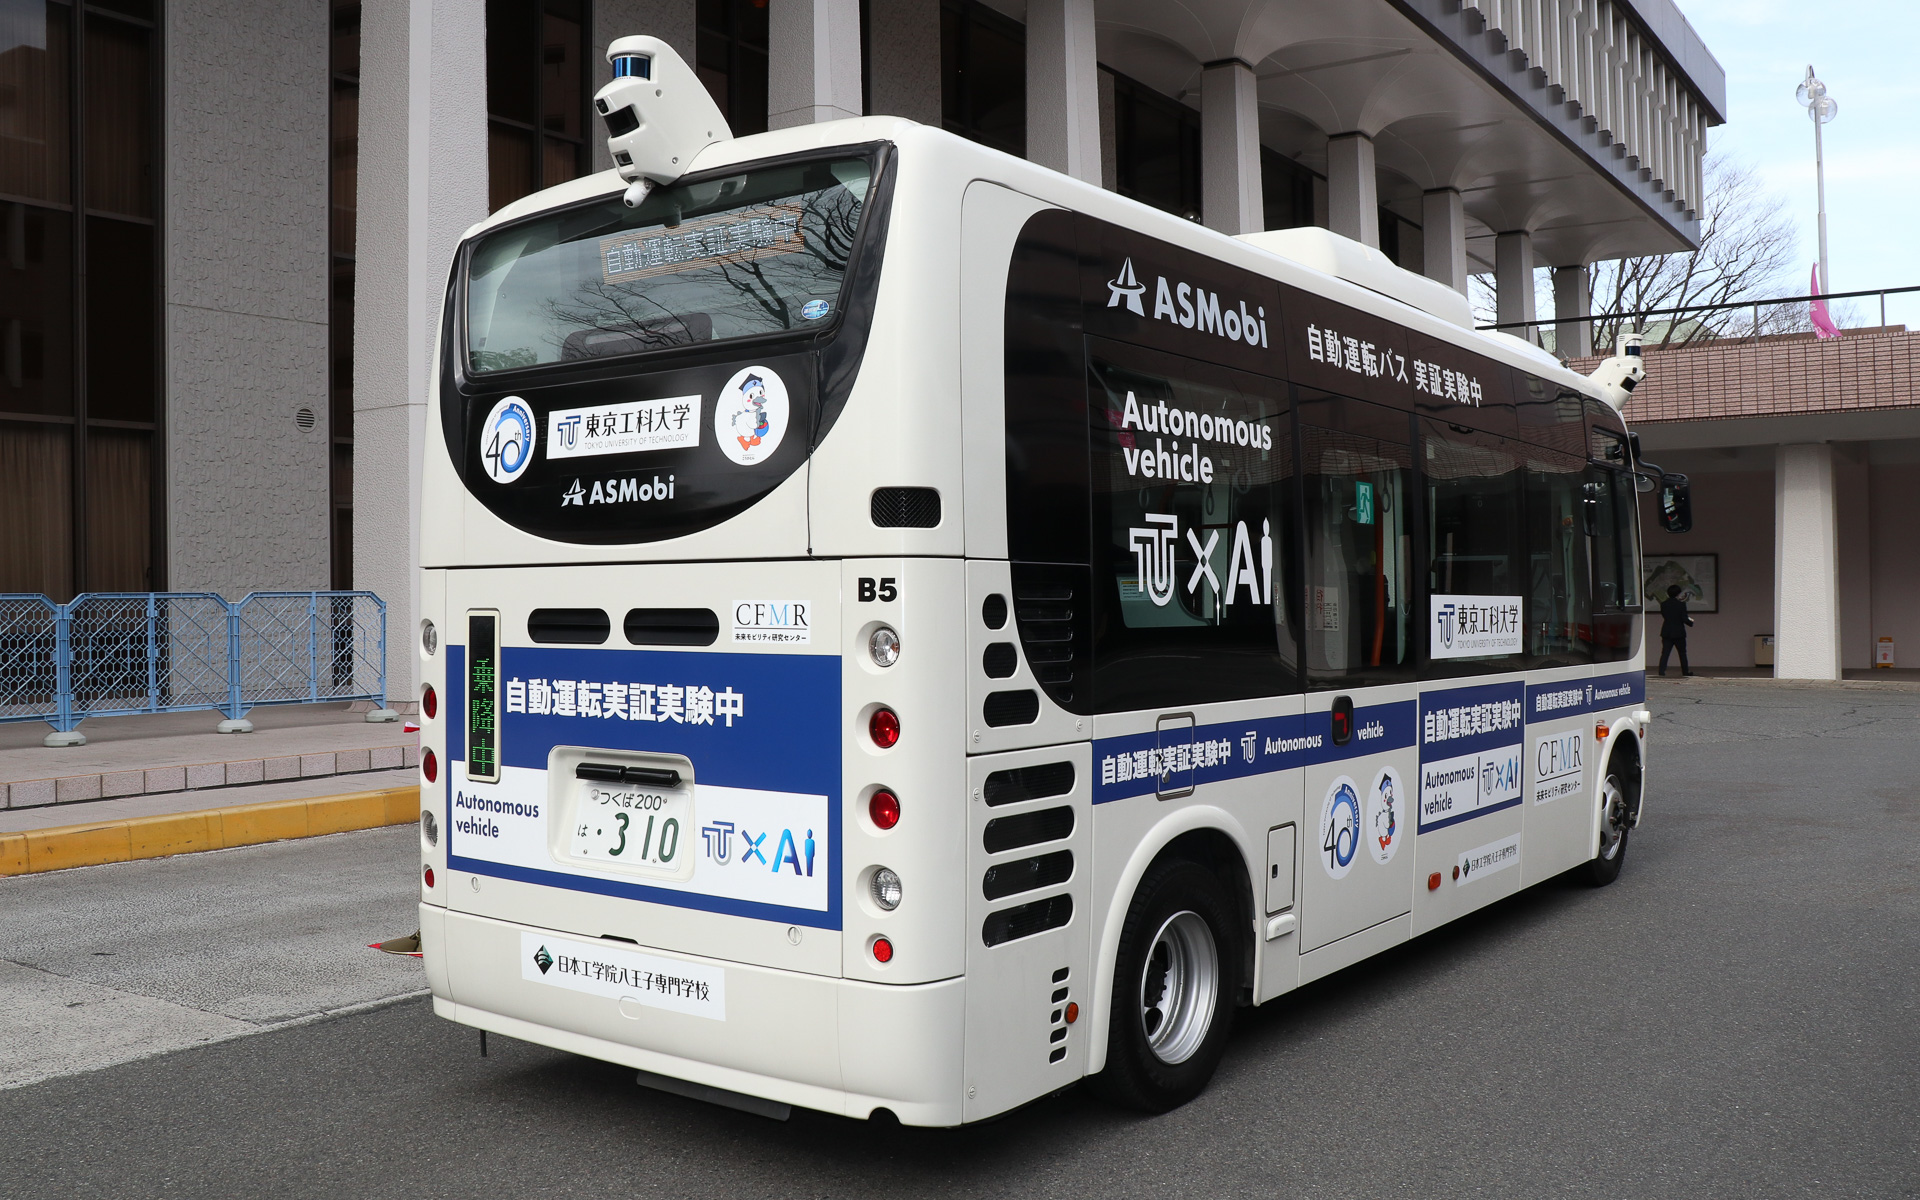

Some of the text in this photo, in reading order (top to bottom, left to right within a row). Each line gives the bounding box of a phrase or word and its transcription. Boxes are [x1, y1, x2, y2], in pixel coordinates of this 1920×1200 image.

[606, 213, 798, 274] 自動運転実証実験中
[1154, 276, 1268, 348] ASMobi
[1307, 323, 1483, 408] 自動運転バス 実証実験中
[584, 403, 690, 438] 東京工科大学
[1121, 390, 1272, 450] Autonomous
[584, 433, 689, 450] TOKYO UNIVERSITY OF TECHNOLOGY
[1122, 438, 1213, 484] vehicle
[589, 474, 675, 505] ASMobi
[858, 577, 898, 603] B5
[736, 604, 808, 627] CFMR
[1457, 604, 1518, 635] 東京工科大学
[735, 633, 807, 642] 未来モビリティ研究センター
[506, 676, 744, 727] 自動運転実証実験中
[1594, 682, 1631, 701] Autonomous vehicle
[472, 658, 495, 774] 乗降中
[1424, 698, 1521, 744] 自動運転実証実験中
[1264, 720, 1384, 755] Autonomous vehicle
[1101, 738, 1231, 785] 自動運転実証実験中
[1537, 735, 1582, 777] CFMR
[1425, 765, 1475, 790] Autonomous
[455, 790, 539, 818] Autonomous
[1424, 791, 1452, 816] vehicle
[455, 815, 499, 839] vehicle
[558, 954, 710, 1002] 日本工学院八王子専門学校
